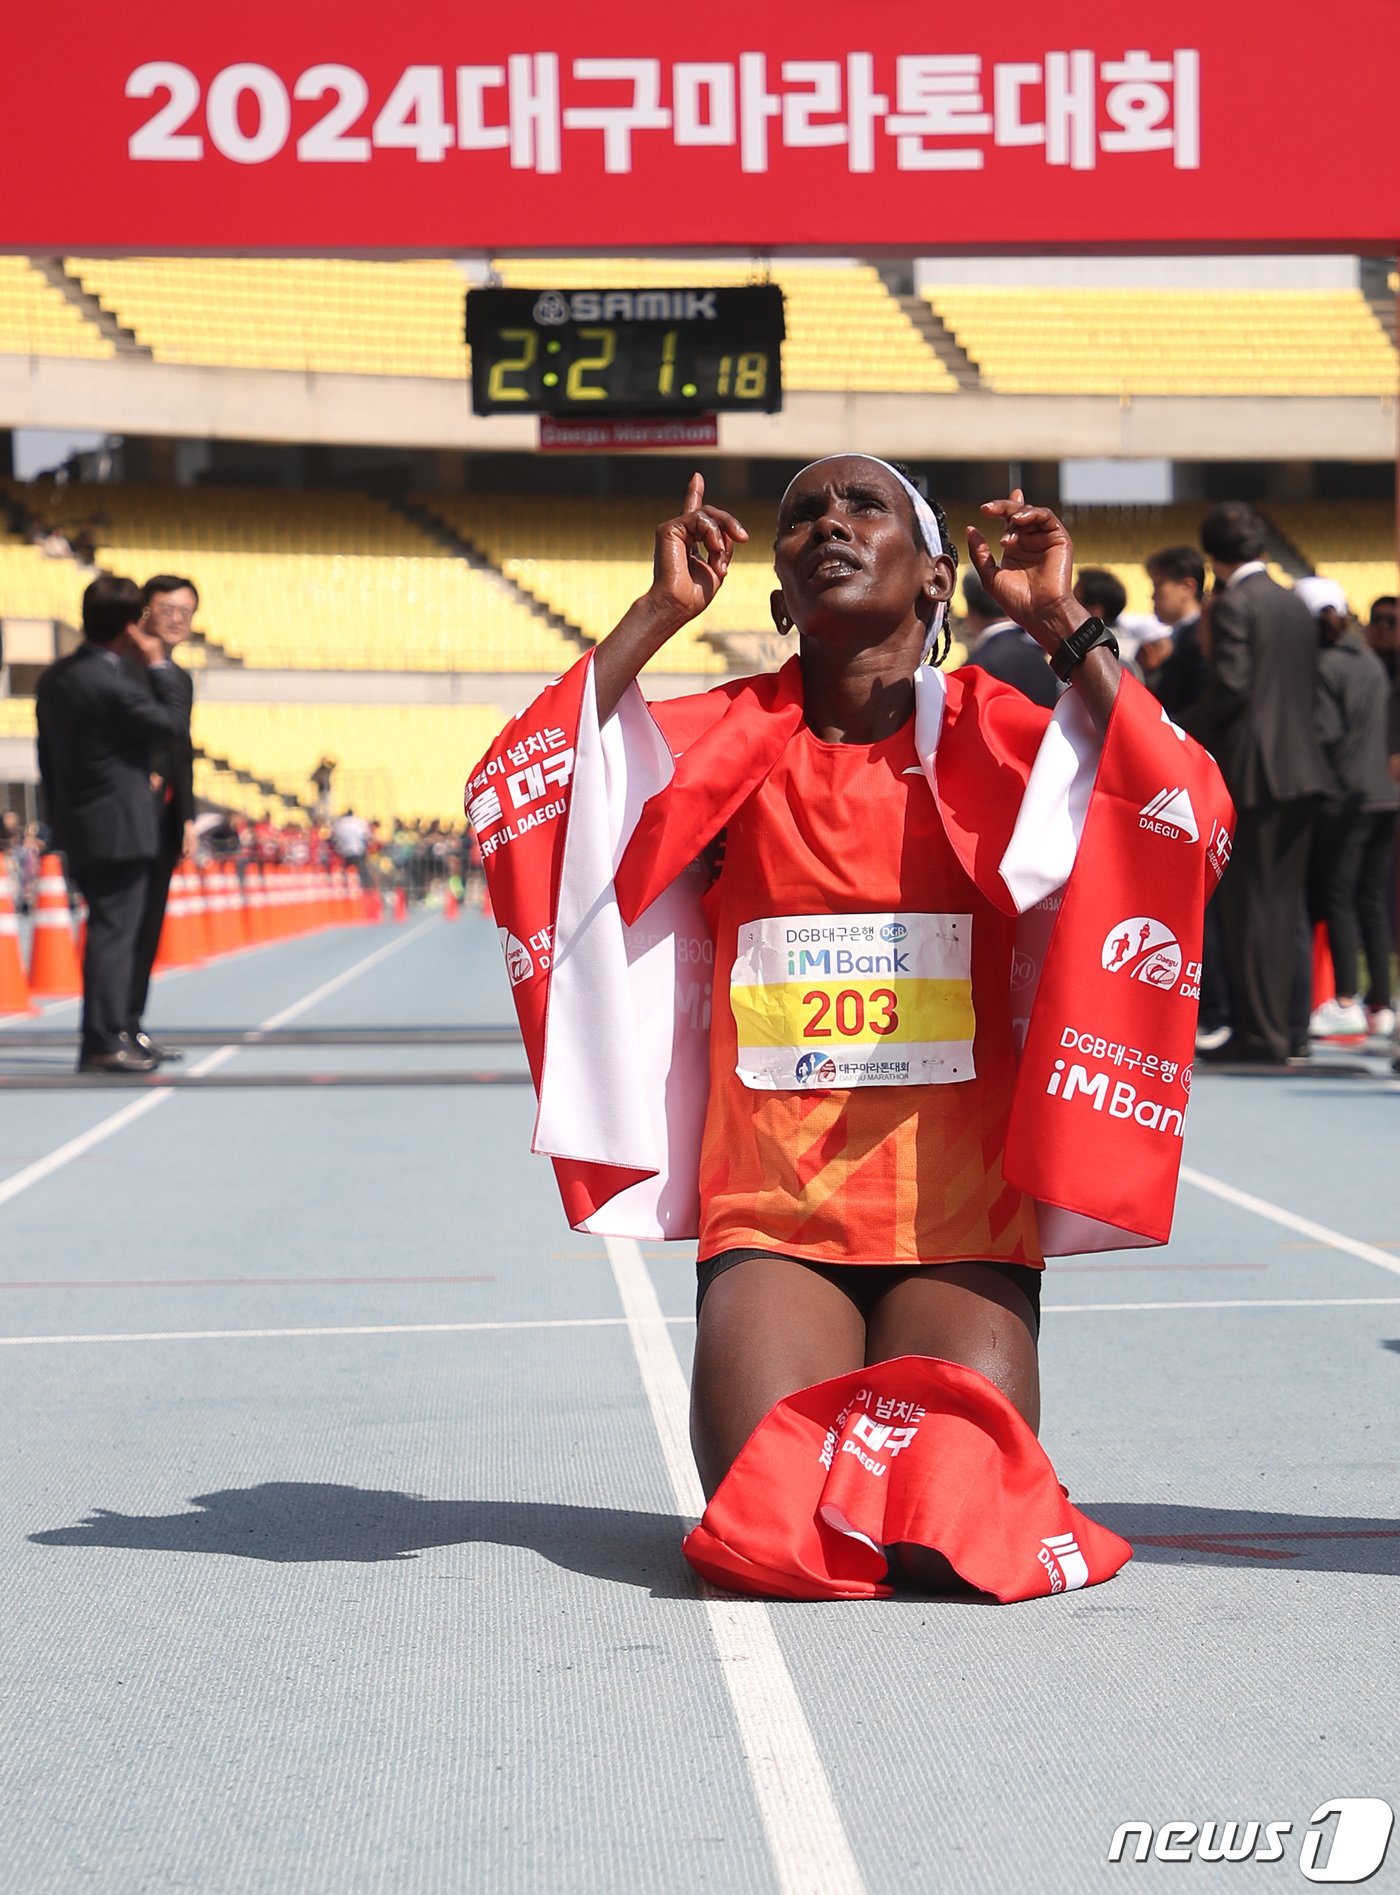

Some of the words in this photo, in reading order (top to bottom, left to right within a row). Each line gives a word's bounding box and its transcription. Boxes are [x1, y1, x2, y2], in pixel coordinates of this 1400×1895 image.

[125, 49, 1200, 174] 2024대구마라톤대회
[570, 292, 717, 321] SAMIK
[506, 727, 567, 767] 넘치는
[506, 747, 575, 810] 대구
[517, 798, 567, 835] DAEGU
[1138, 817, 1180, 840] DAEGU
[786, 927, 875, 943] DGB대구은행
[1156, 953, 1178, 968] Daegu
[802, 988, 899, 1037] 203
[839, 1061, 910, 1074] 대구마라톤대회
[1060, 1027, 1179, 1083] DGB대구은행
[867, 1073, 909, 1081] MARATHON
[852, 1413, 919, 1457] 대구
[842, 1439, 887, 1477] DAEGU
